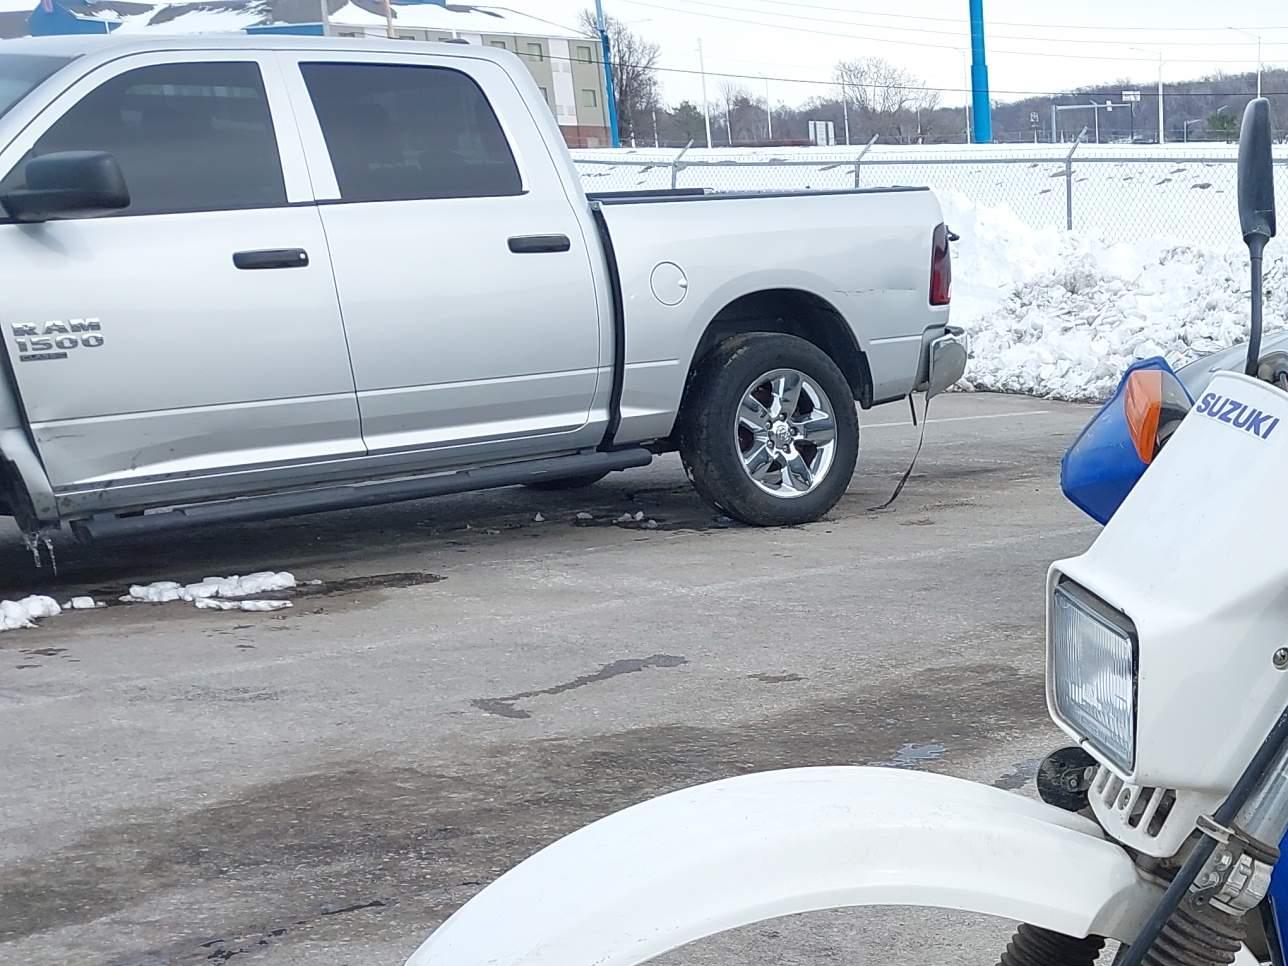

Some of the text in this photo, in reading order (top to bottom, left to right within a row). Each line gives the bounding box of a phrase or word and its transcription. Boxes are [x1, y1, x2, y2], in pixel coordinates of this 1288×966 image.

[11, 318, 101, 336] RAM
[15, 334, 104, 352] 1500
[1196, 393, 1280, 440] SUZUKI
